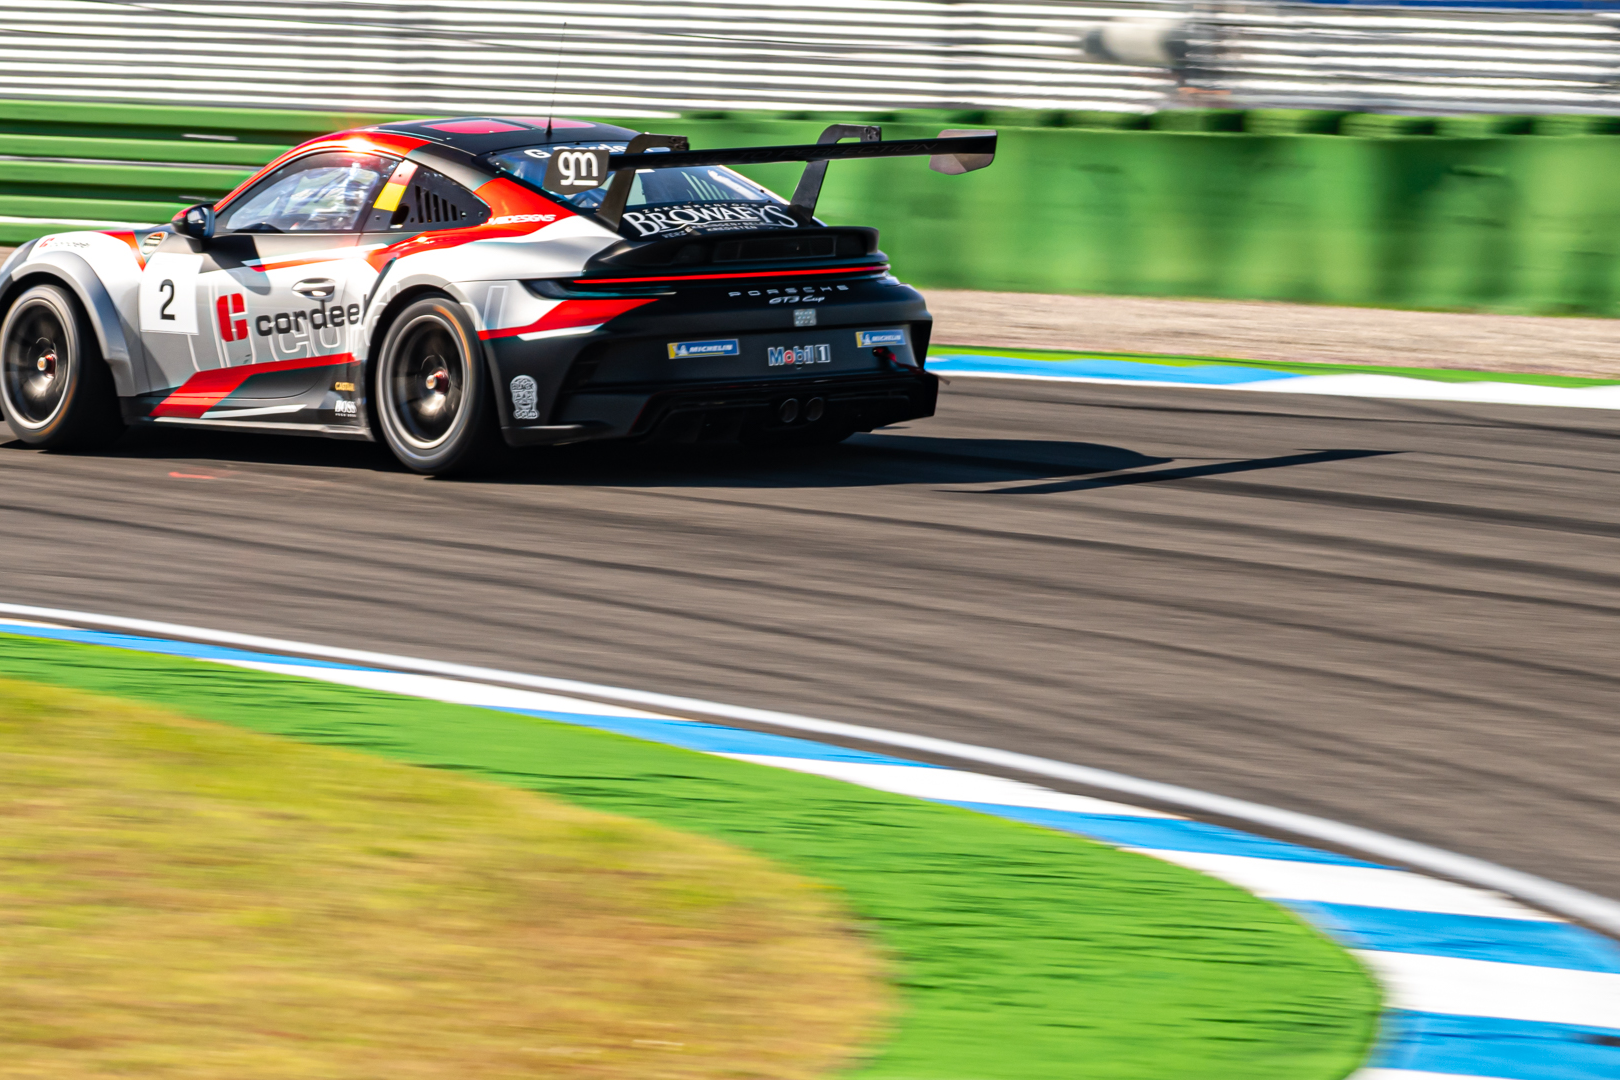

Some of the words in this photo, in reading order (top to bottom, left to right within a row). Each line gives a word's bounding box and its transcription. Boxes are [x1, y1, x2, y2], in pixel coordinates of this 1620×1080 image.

[622, 205, 798, 237] BROWAEYS
[159, 278, 177, 321] 2
[728, 284, 850, 297] PORSCHE
[768, 295, 801, 305] GT3
[801, 294, 826, 303] Cup
[689, 344, 733, 353] MICHELIN
[767, 345, 814, 367] Mobil
[816, 344, 829, 363] 1
